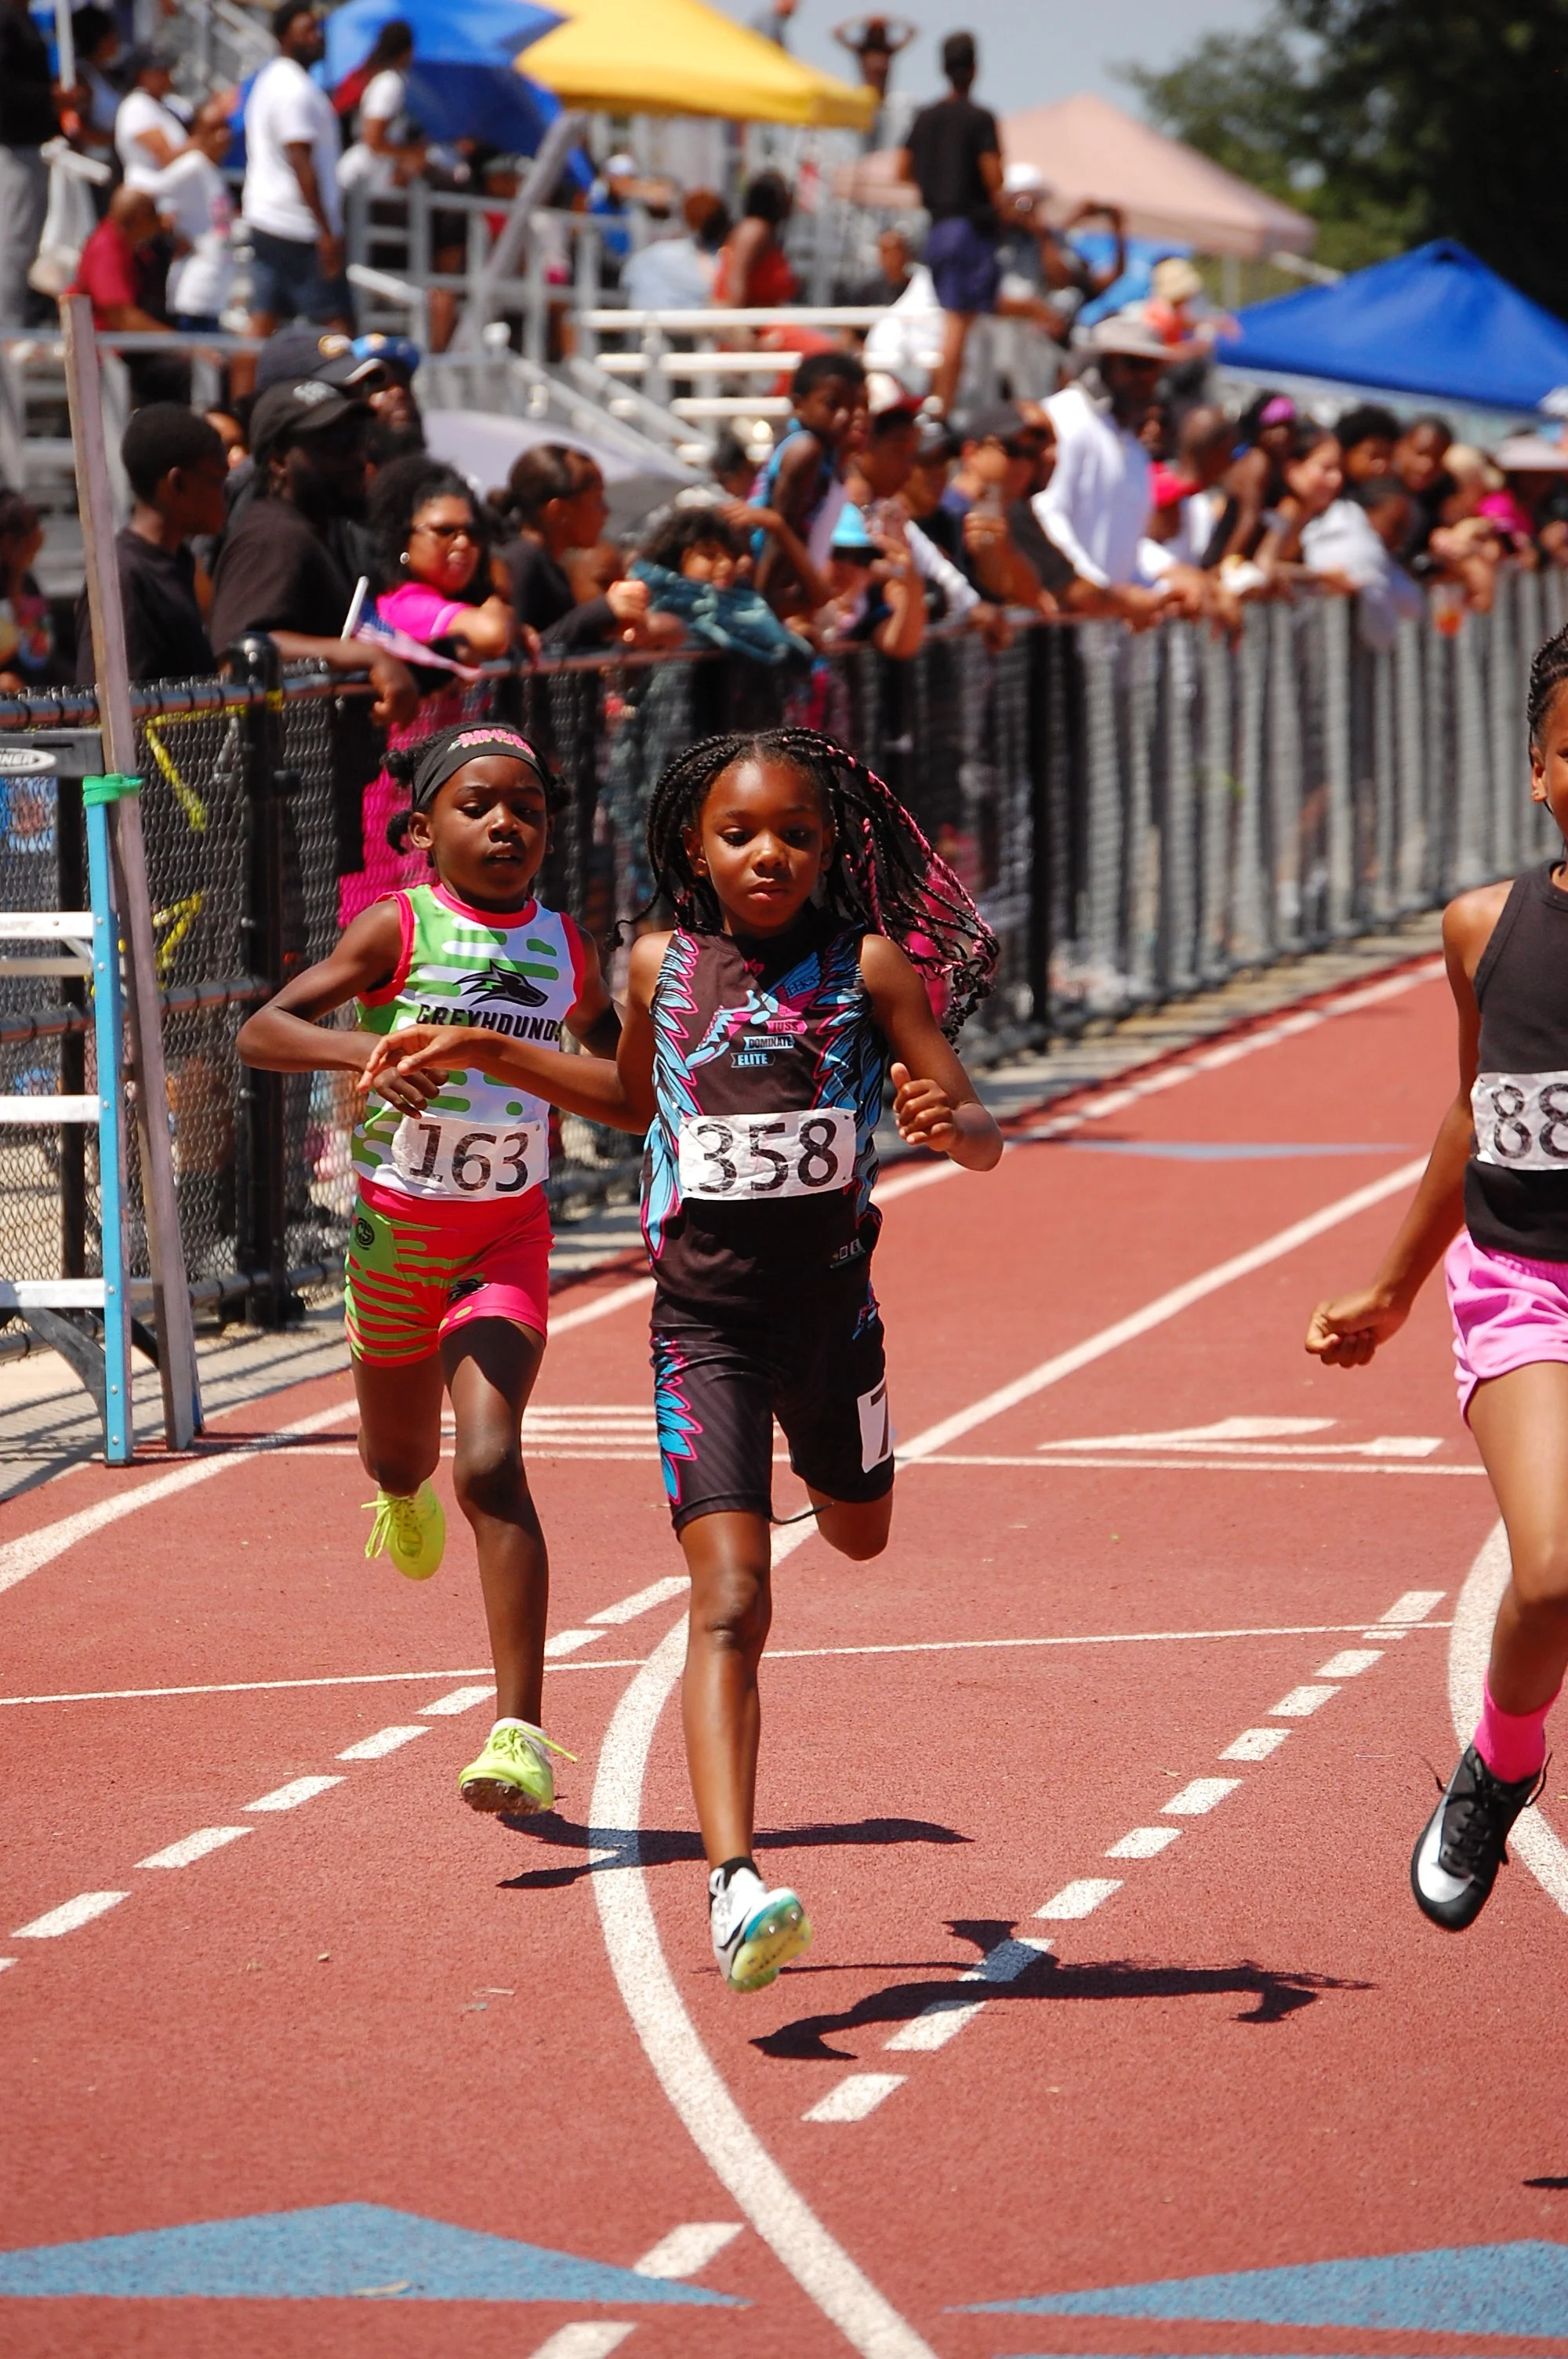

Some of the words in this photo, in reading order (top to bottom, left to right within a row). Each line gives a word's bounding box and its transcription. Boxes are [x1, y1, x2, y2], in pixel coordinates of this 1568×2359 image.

[737, 1052, 768, 1066] ELITE
[749, 1034, 793, 1049] DOMINATE
[697, 1118, 838, 1194] 358
[1491, 1083, 1568, 1159] 88
[409, 1123, 528, 1193] 163
[869, 1380, 889, 1459] 7
